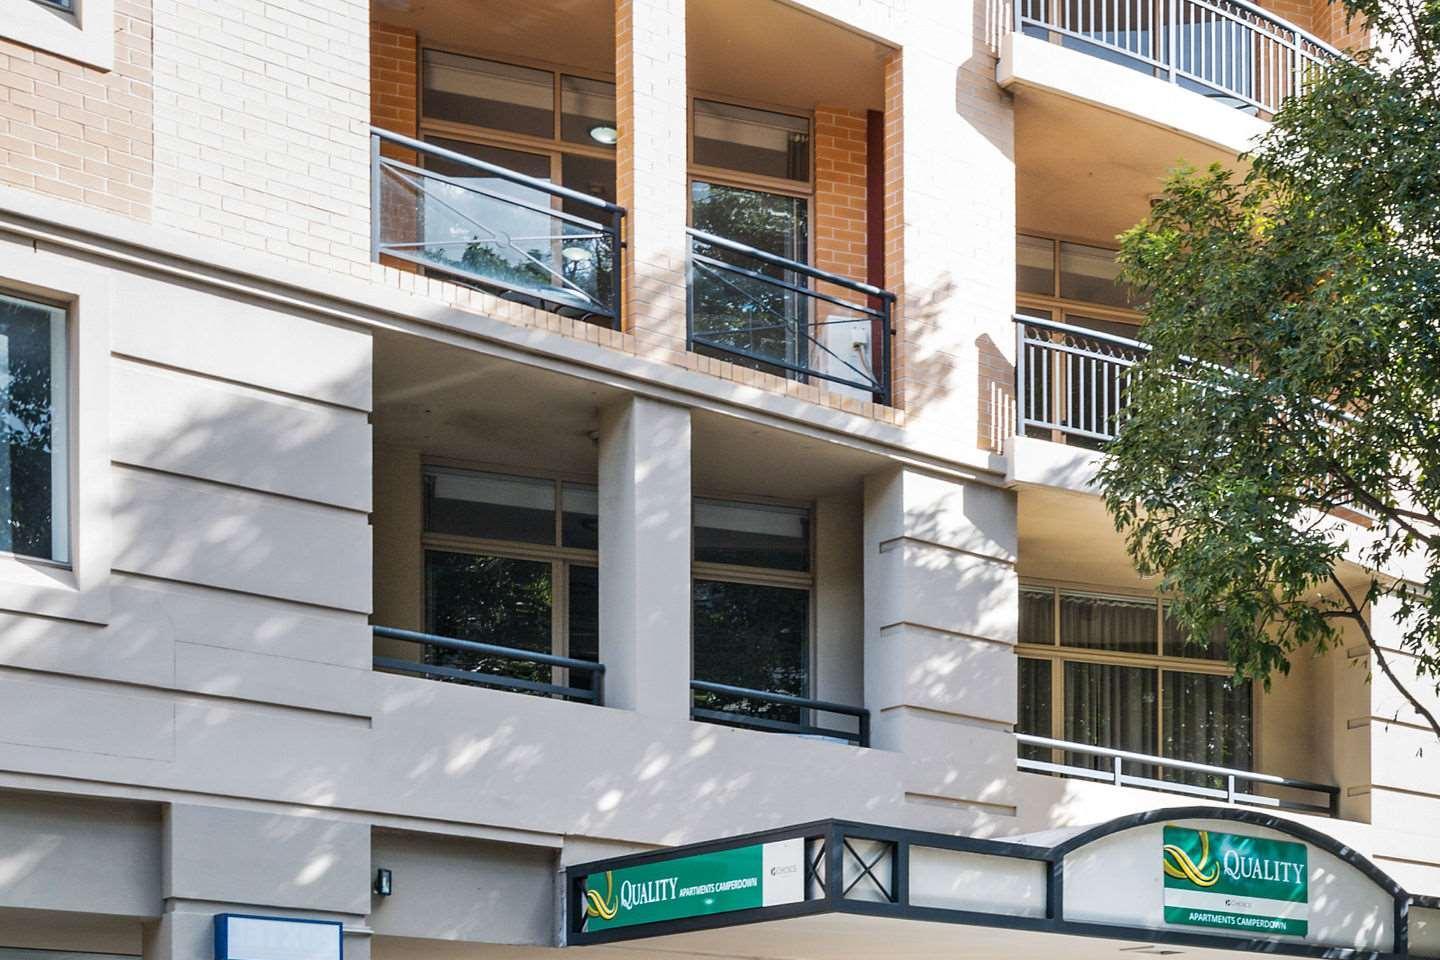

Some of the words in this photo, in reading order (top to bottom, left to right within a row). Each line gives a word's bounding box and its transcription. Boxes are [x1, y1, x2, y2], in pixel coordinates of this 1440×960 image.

[1223, 850, 1304, 884] QUALITY
[620, 877, 679, 909] QUALITY
[679, 884, 715, 898] APARTMENTS
[715, 877, 758, 893] CAMPERDOWN
[1189, 912, 1235, 925] APARTMENTS
[1237, 917, 1287, 931] CAMPERDOWN
